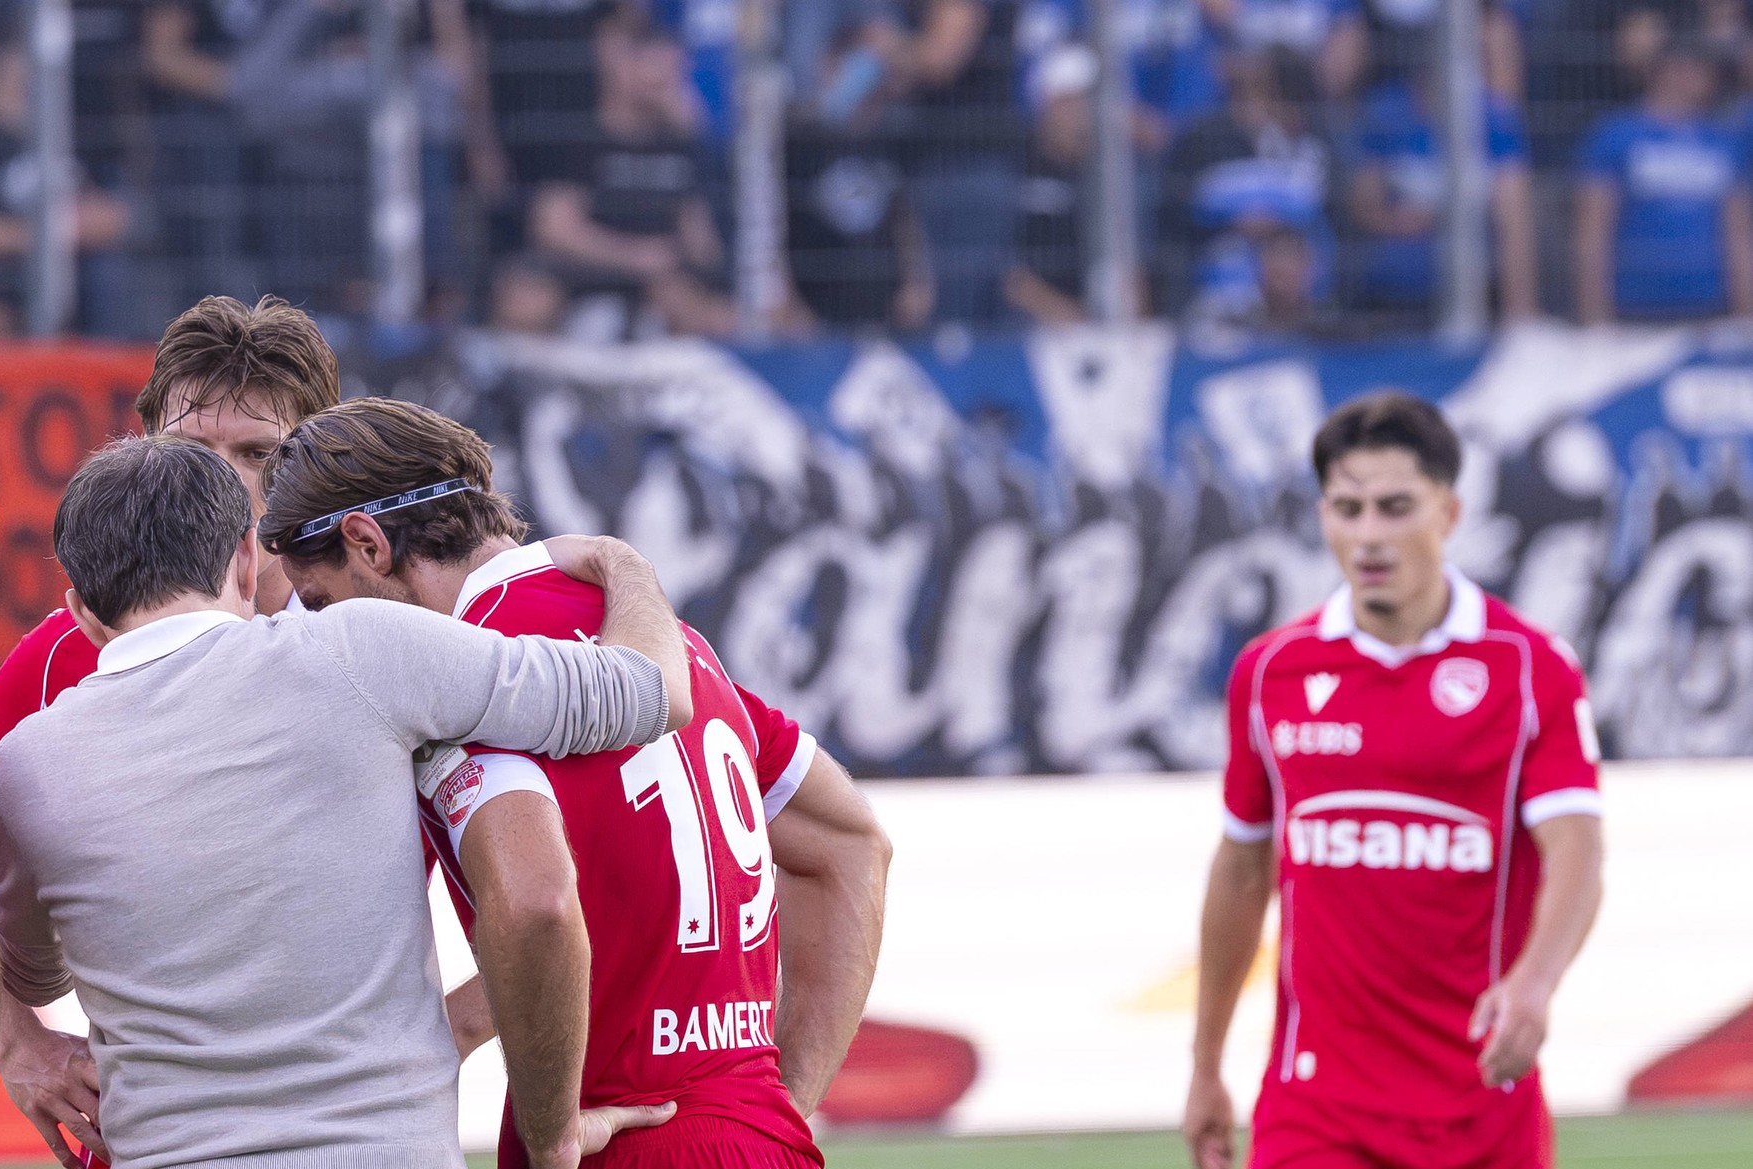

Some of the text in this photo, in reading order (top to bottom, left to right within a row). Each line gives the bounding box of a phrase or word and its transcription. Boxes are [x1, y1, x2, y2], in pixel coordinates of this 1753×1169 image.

[363, 501, 383, 514] NIKE
[398, 491, 418, 505] NIKE
[620, 717, 779, 954] 19
[652, 1001, 774, 1055] BAMERT
